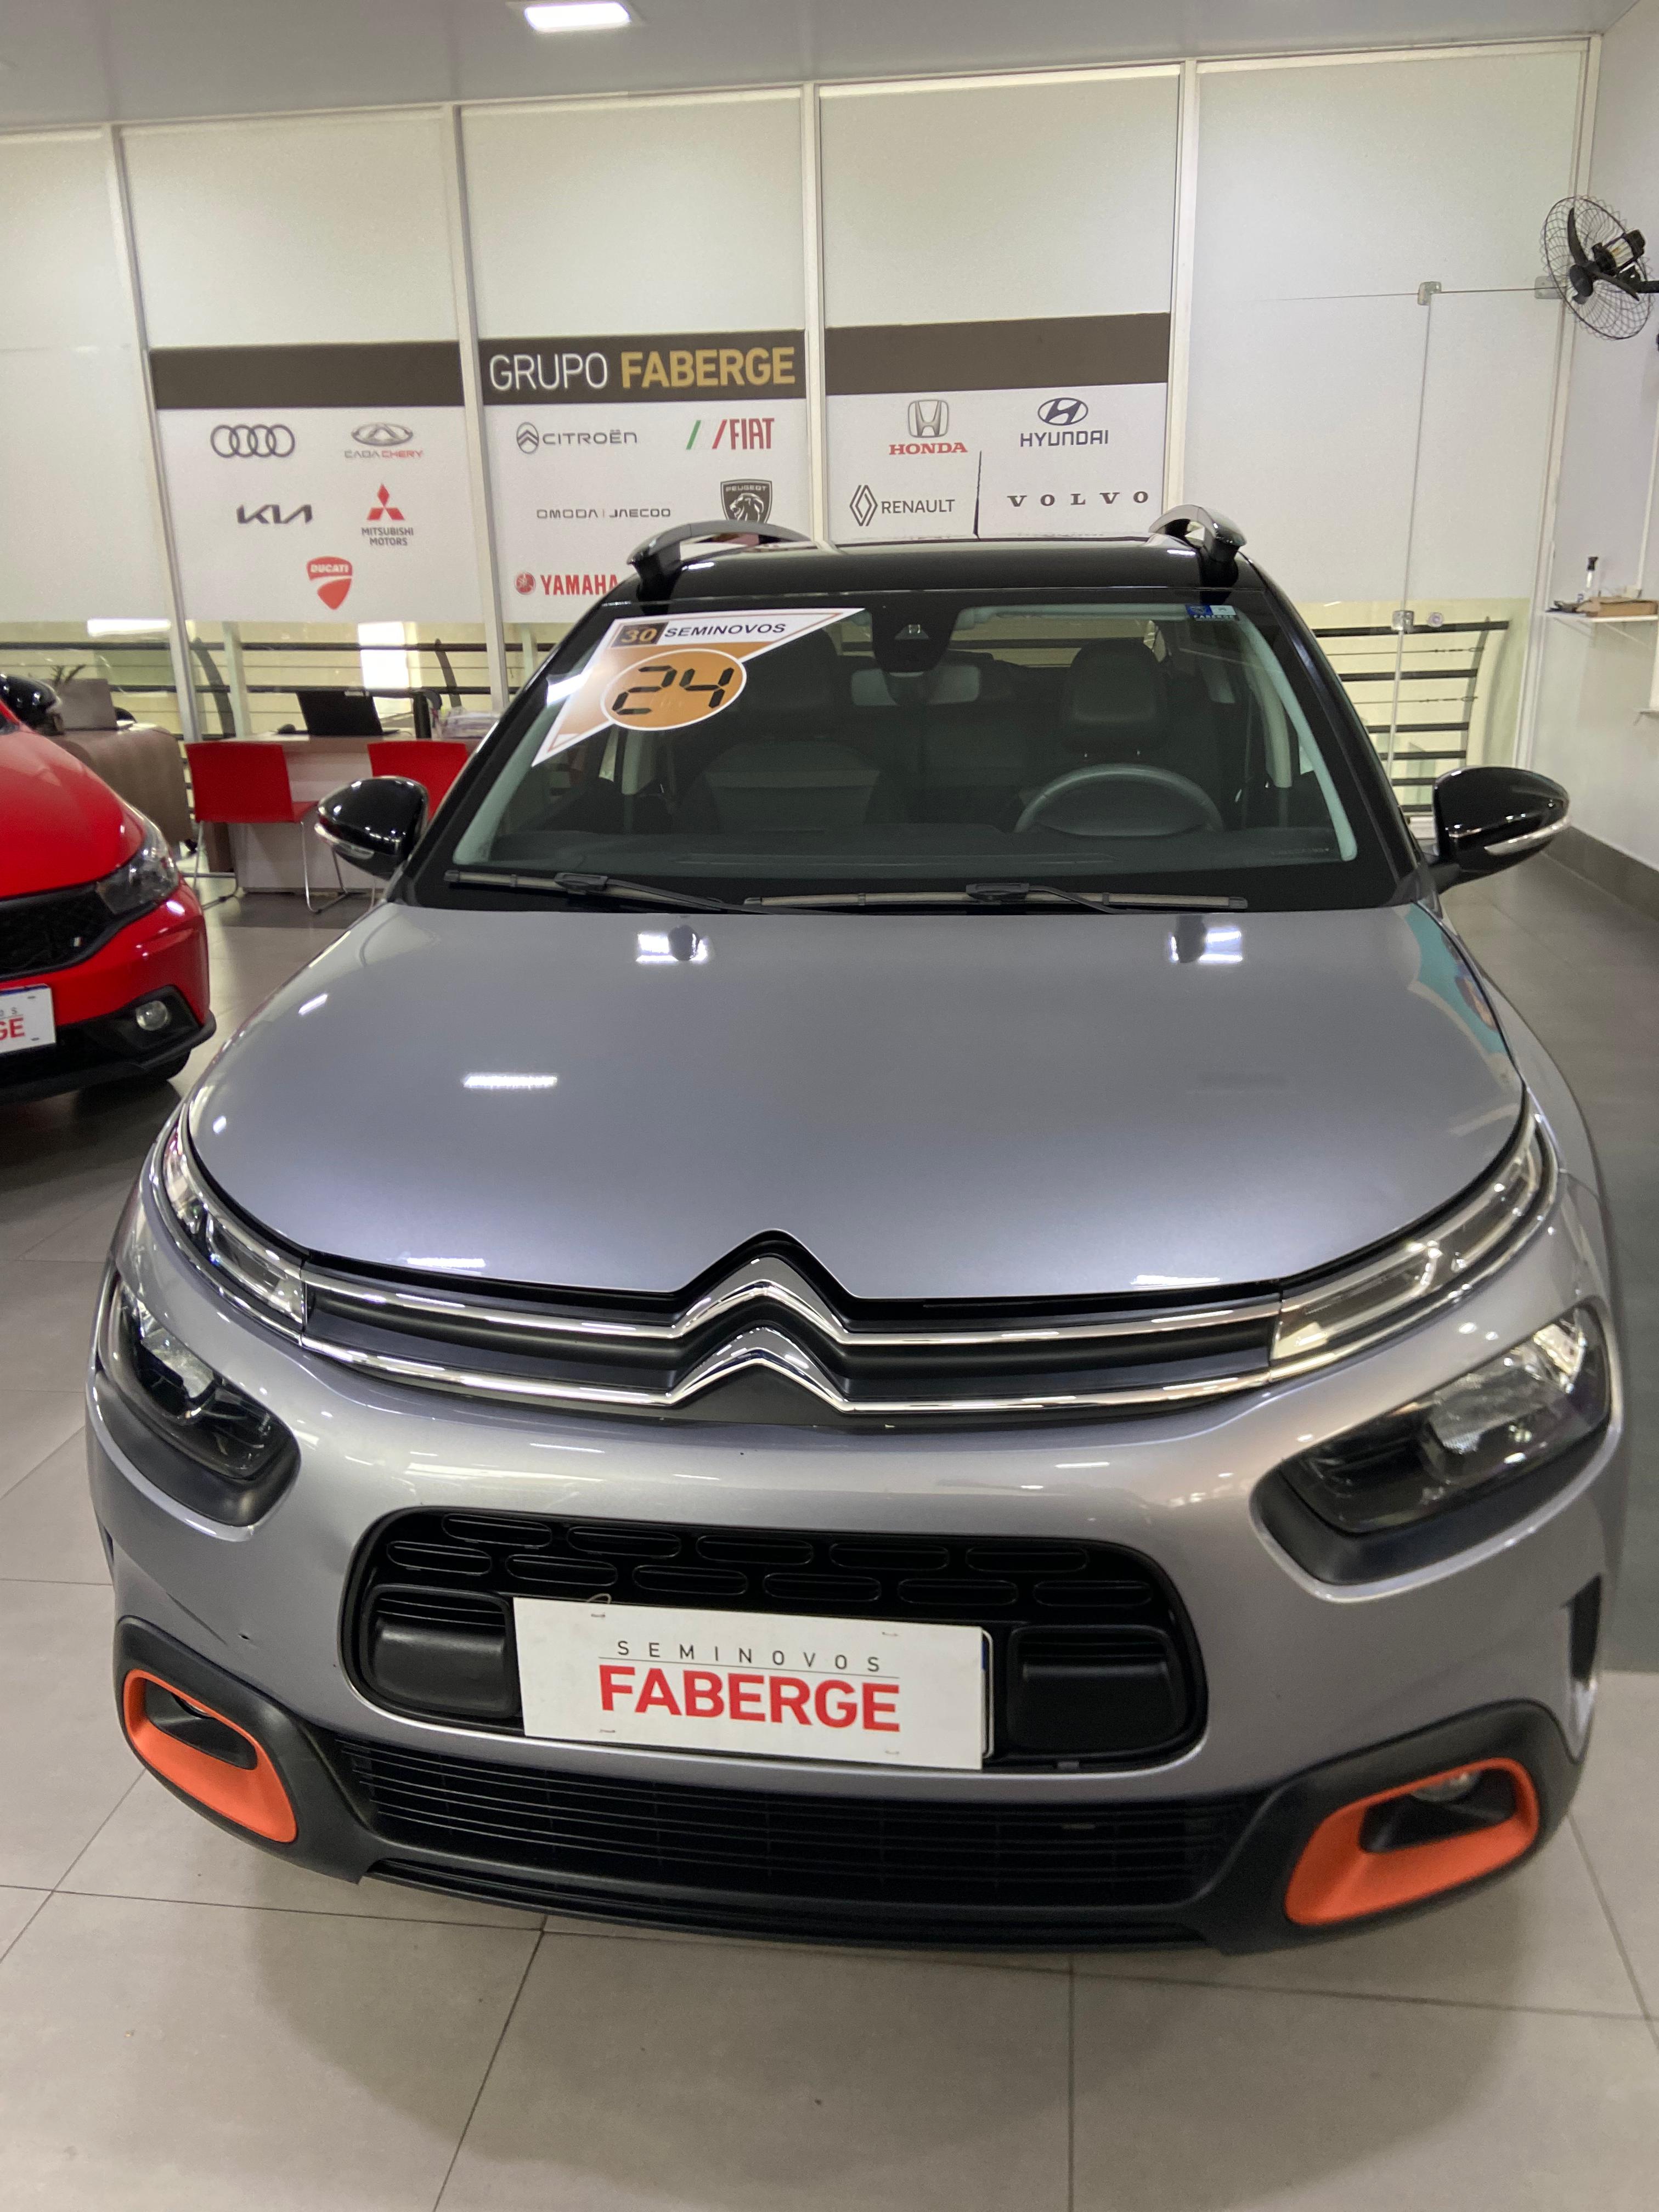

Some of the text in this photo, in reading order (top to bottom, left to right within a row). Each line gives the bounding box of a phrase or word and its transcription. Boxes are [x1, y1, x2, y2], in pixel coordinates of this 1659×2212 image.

[490, 346, 795, 392] GRUPO FABERGE
[729, 417, 775, 450] FIAT
[1020, 430, 1108, 447] HYUNDAI
[381, 450, 423, 458] CHERY
[889, 442, 968, 455] HONDA
[881, 498, 956, 514] RENAULT
[1007, 490, 1149, 507] VOLVO
[236, 504, 313, 524] KIA
[537, 508, 670, 519] OMODA JAECOO
[362, 527, 414, 537] MITSUBISHI
[369, 537, 408, 546] MOTORS
[310, 563, 349, 573] DUCATI
[621, 623, 786, 644] 30 SEMINOVOS
[612, 665, 735, 715] 24
[617, 1640, 880, 1672] SEMINOVOS
[599, 1664, 900, 1733] FABERGE
